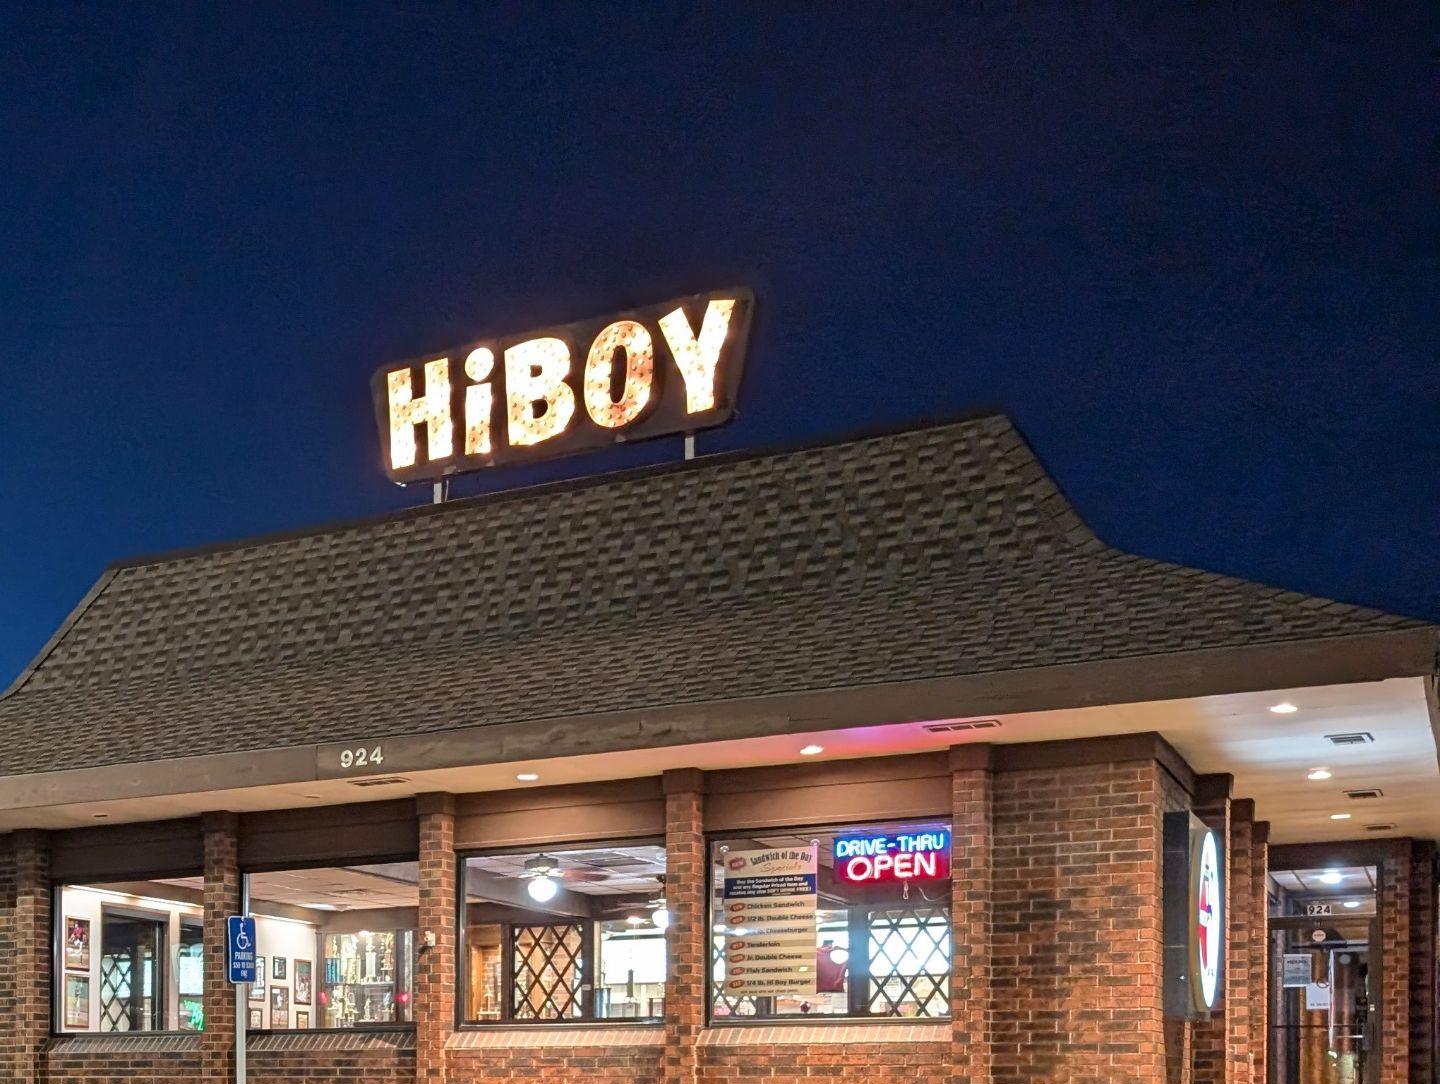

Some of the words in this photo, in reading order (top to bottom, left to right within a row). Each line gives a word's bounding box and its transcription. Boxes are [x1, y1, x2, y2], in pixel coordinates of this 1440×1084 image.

[341, 746, 383, 768] 924
[781, 851, 787, 859] of
[789, 851, 799, 859] the
[837, 833, 944, 857] DRIVE-THRU
[847, 852, 936, 880] OPEN
[1308, 905, 1330, 914] 924
